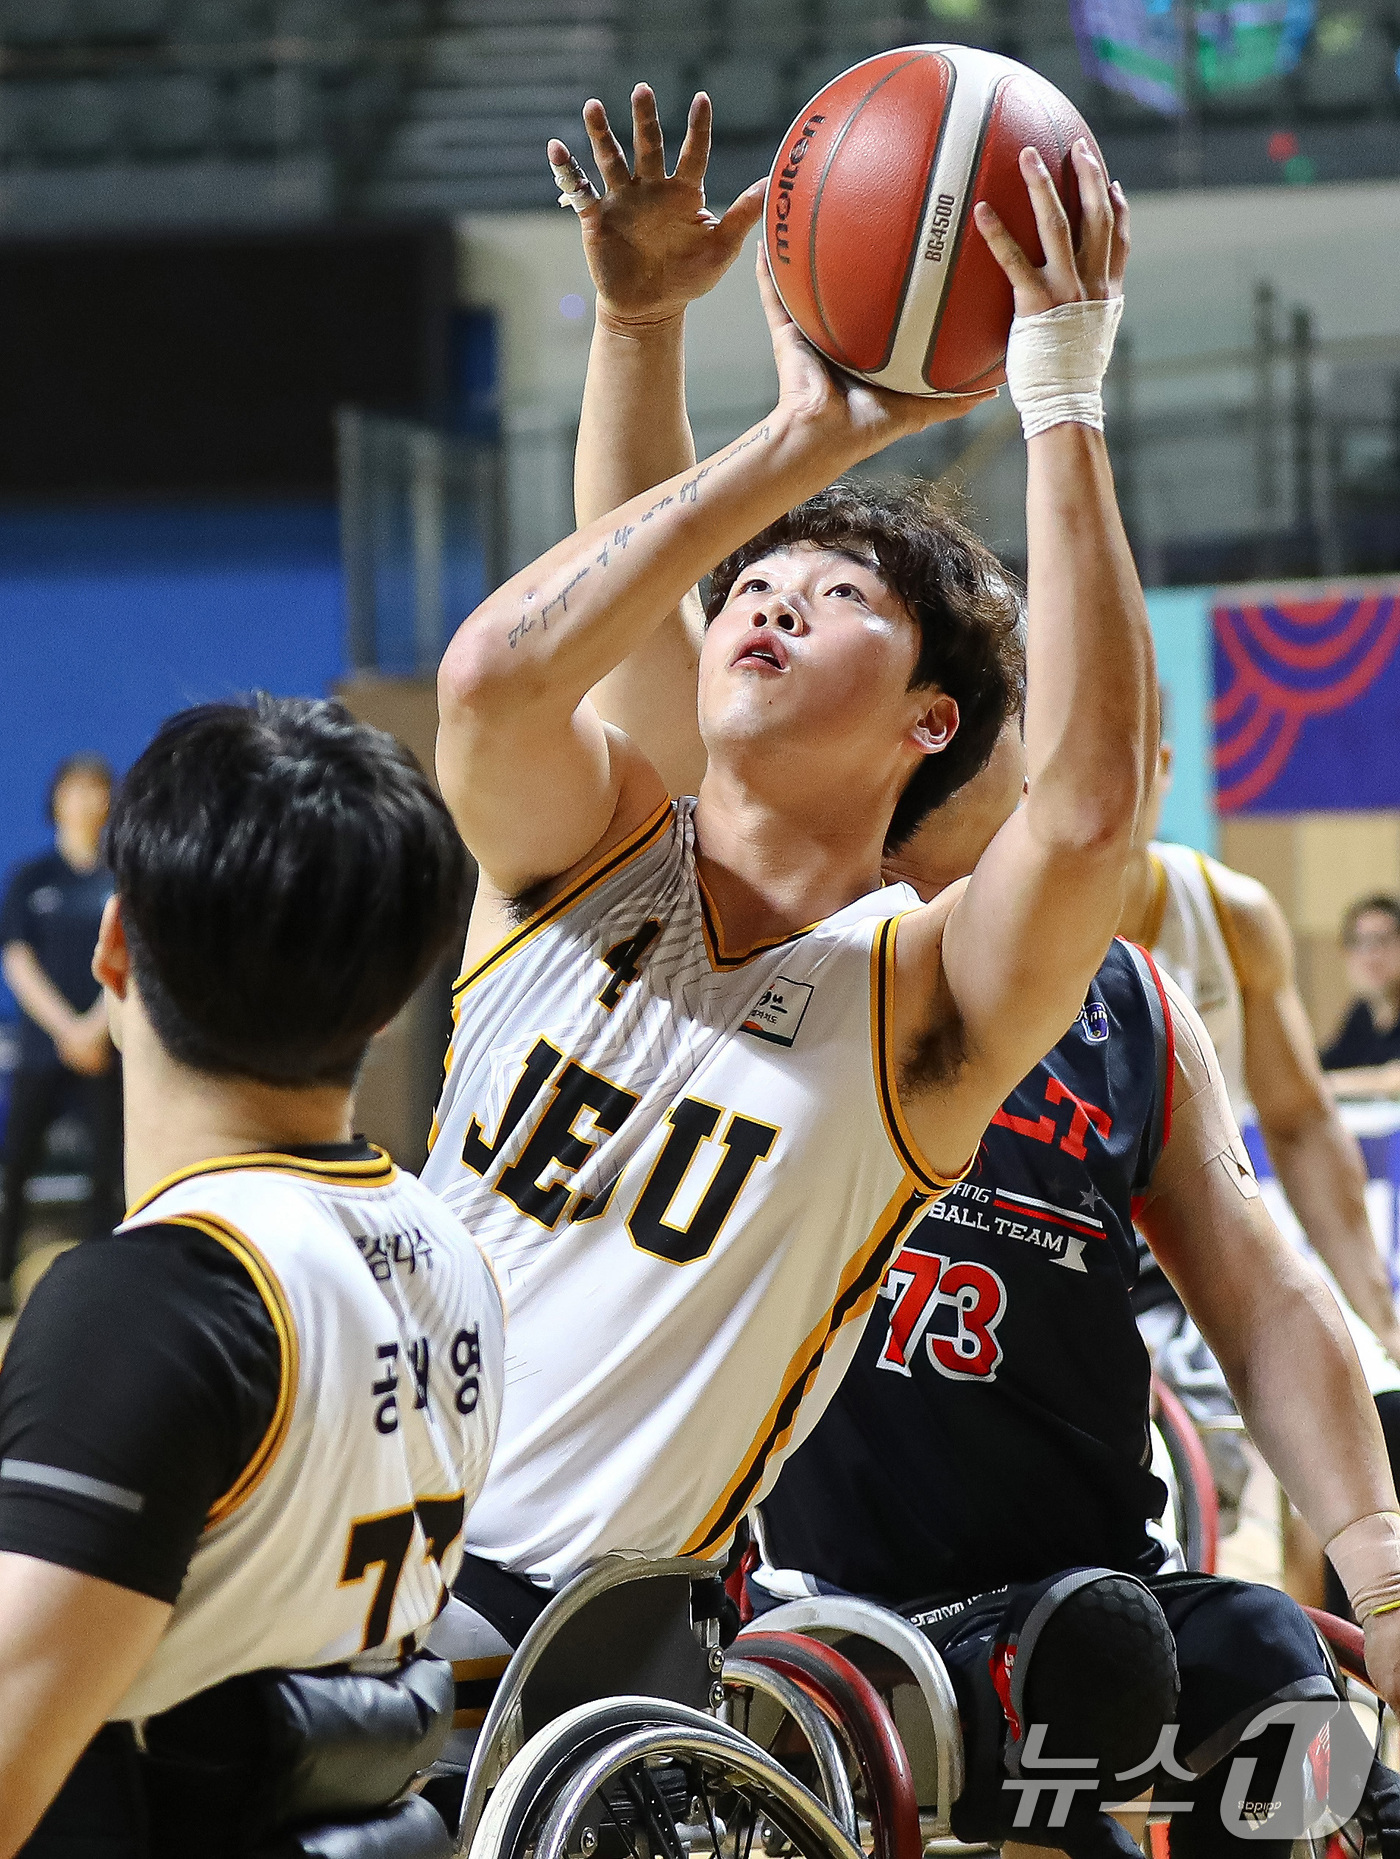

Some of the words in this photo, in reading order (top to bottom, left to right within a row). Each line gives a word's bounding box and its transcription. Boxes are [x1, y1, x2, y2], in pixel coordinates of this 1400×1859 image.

[774, 114, 826, 265] molten
[924, 193, 956, 262] BG4500
[507, 612, 536, 650] The
[596, 542, 610, 567] of
[614, 525, 635, 550] life
[597, 916, 666, 1013] 4
[994, 1217, 1064, 1253] TEAM
[876, 1246, 1008, 1383] 73
[1237, 1800, 1282, 1812] adidas
